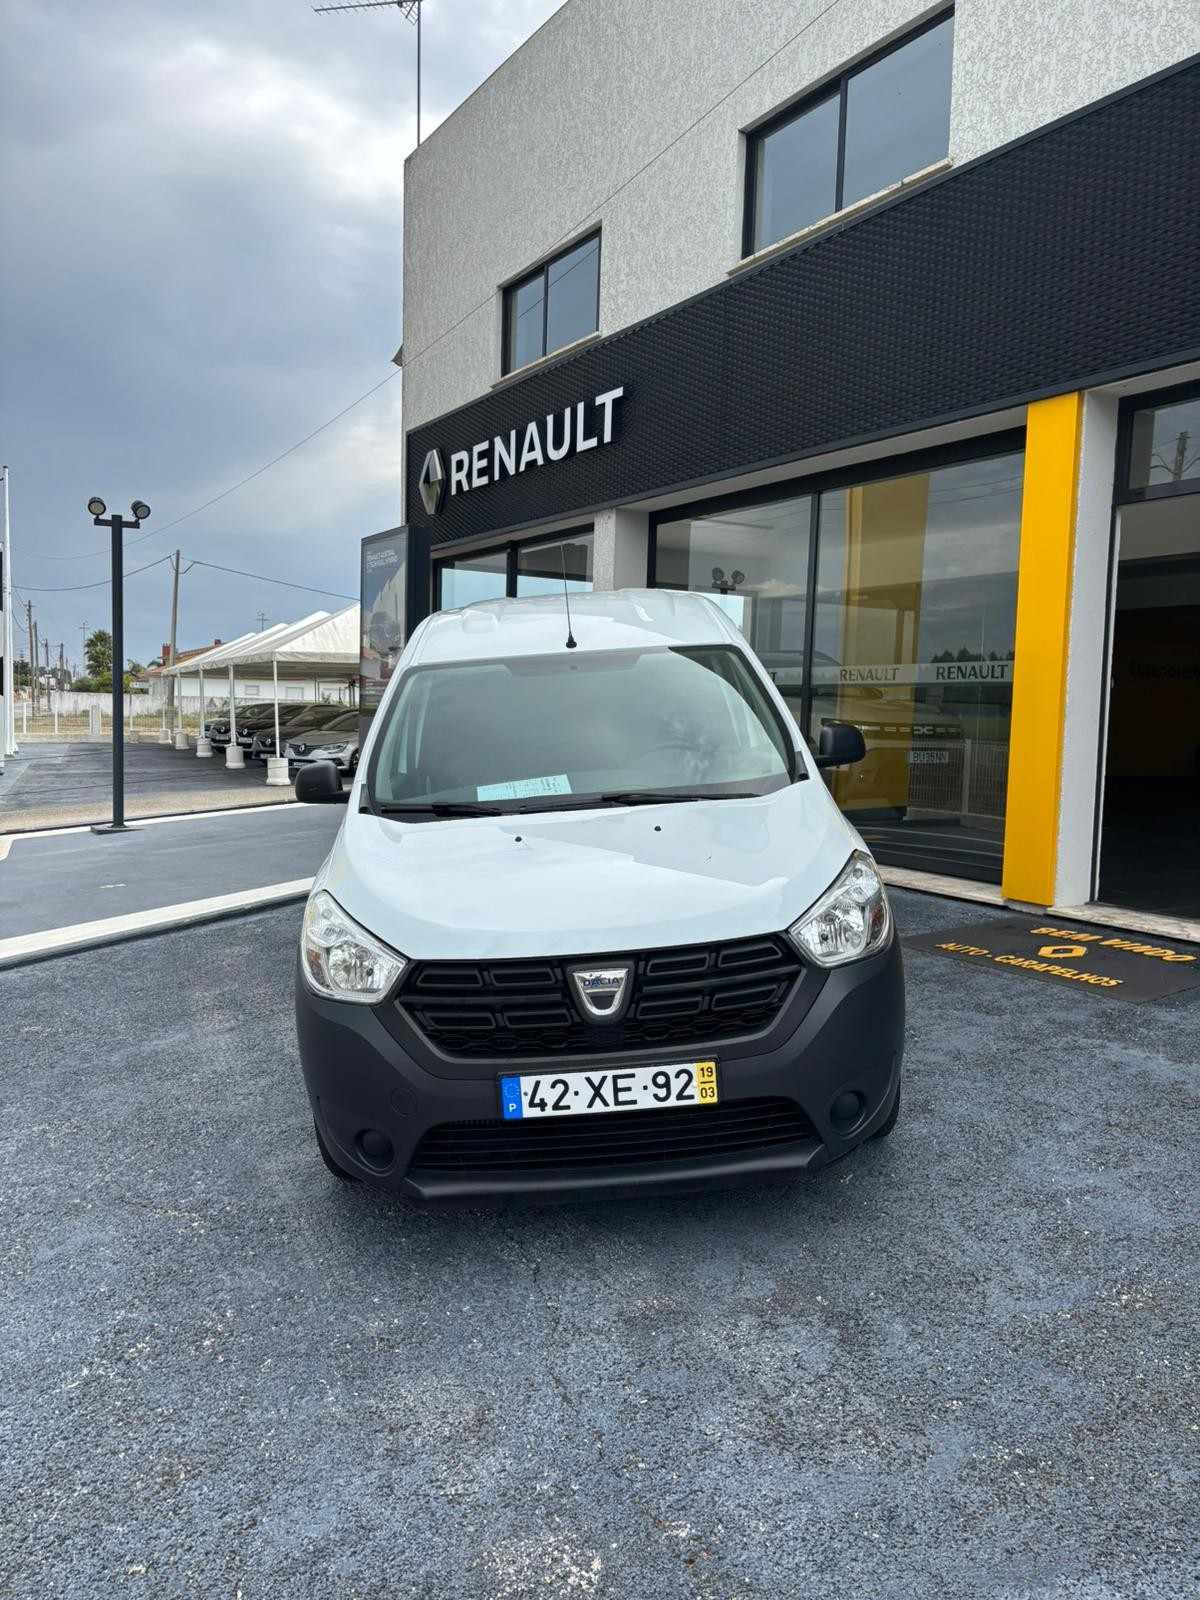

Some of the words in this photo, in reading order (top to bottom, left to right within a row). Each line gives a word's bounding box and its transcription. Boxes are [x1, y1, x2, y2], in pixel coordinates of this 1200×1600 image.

[450, 386, 624, 496] RENAULT
[839, 668, 899, 682] RENAULT
[935, 664, 1008, 681] RENAULT
[1030, 927, 1103, 942] BEM
[1099, 938, 1197, 962] VINDO
[994, 954, 1124, 987] CARAPELHOS
[583, 977, 619, 986] DACIA
[700, 1066, 714, 1078] 19
[700, 1086, 715, 1098] 03
[508, 1103, 517, 1113] P
